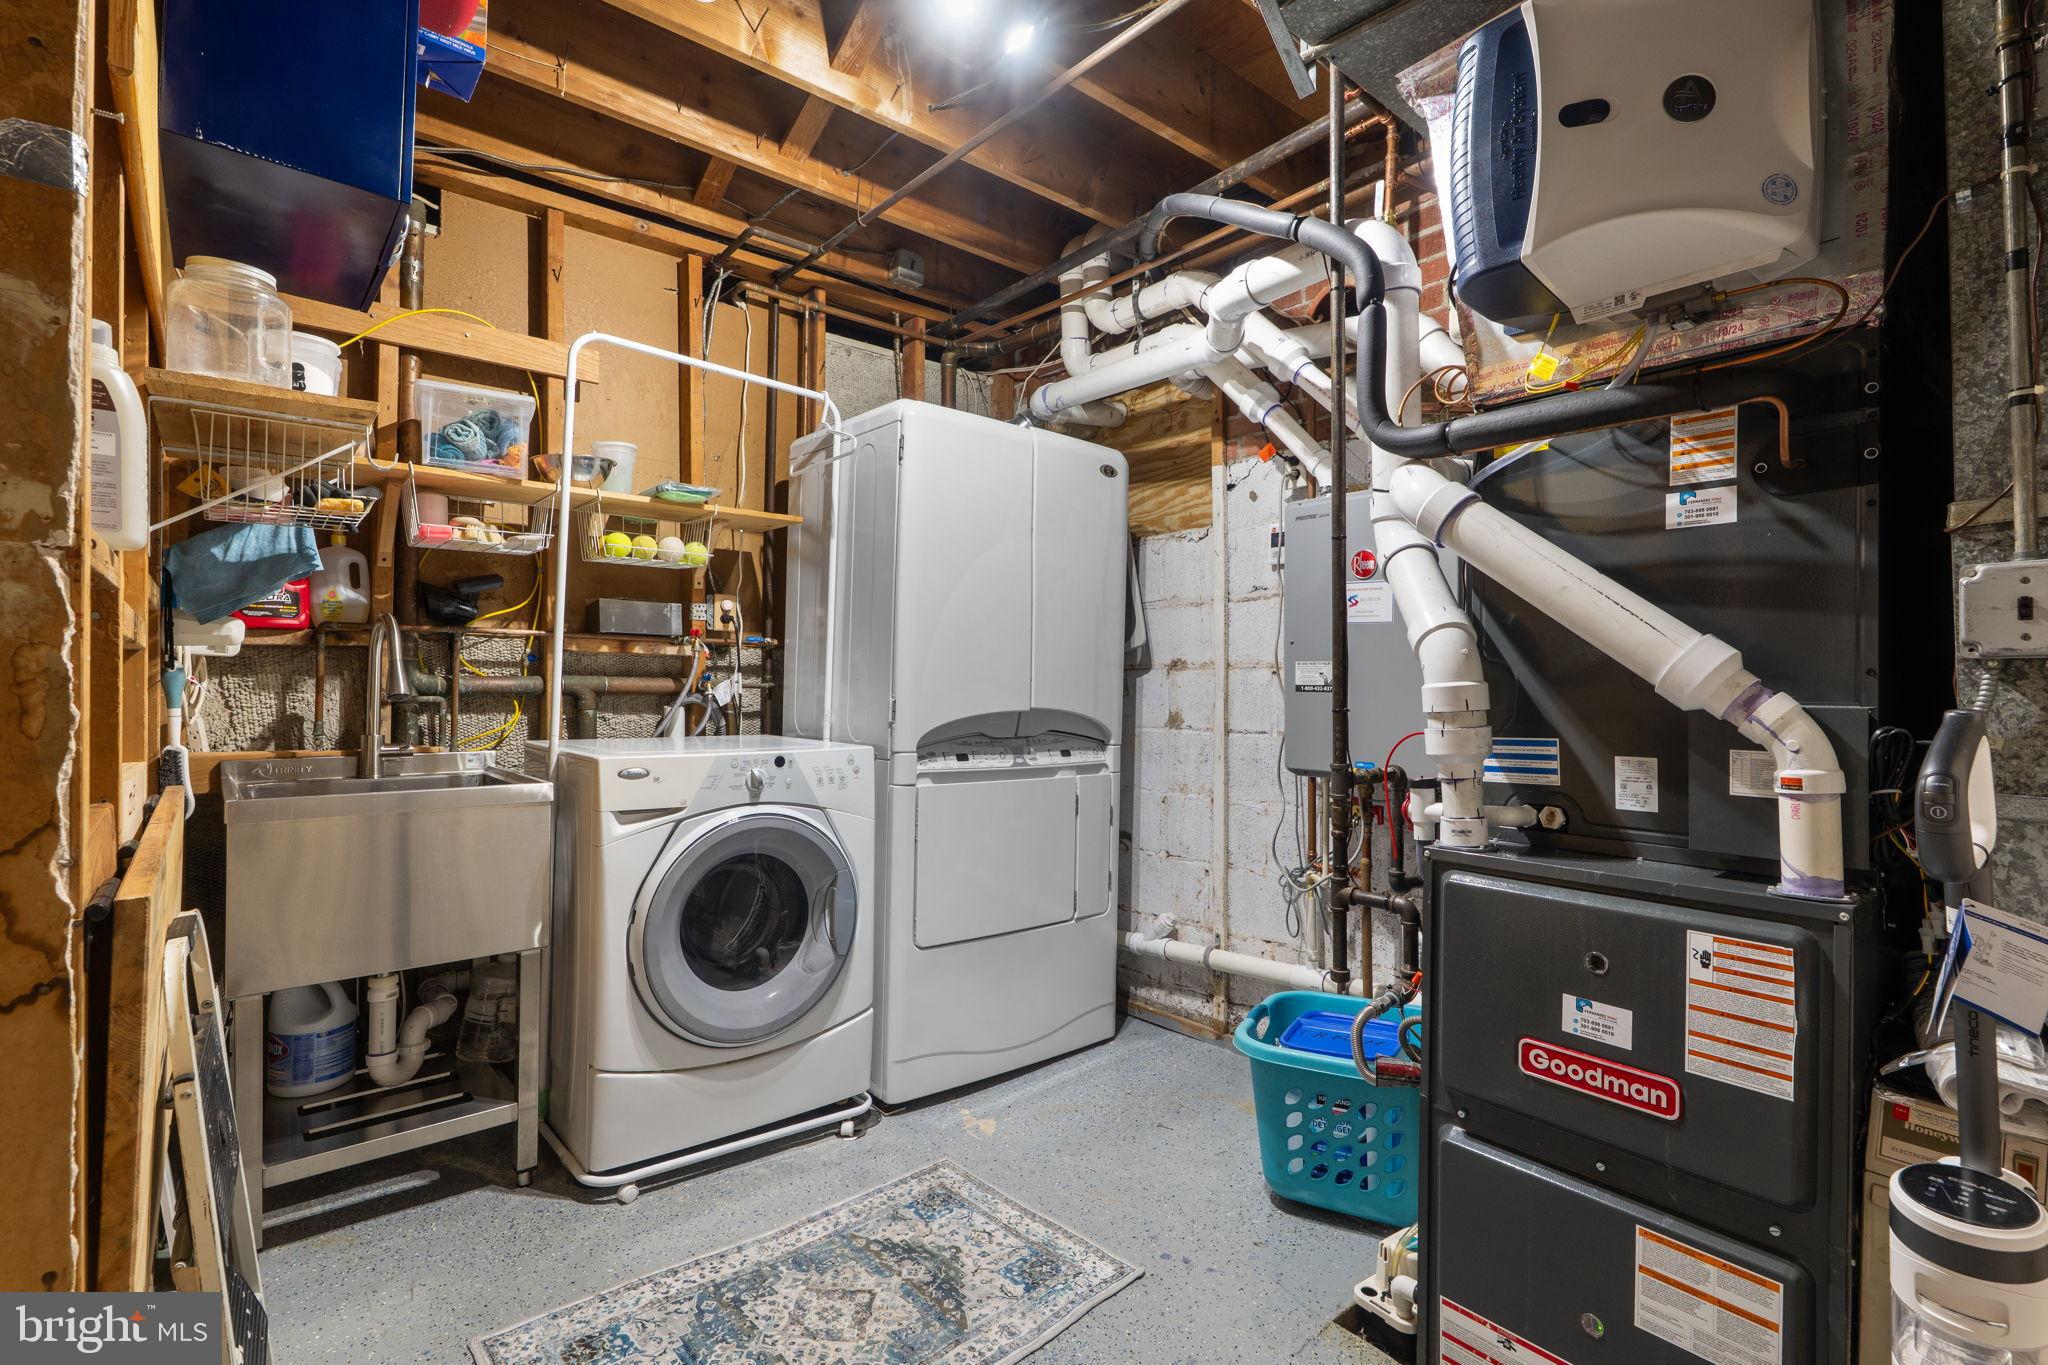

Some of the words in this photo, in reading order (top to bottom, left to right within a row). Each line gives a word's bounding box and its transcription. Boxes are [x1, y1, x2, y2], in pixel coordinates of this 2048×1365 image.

[1716, 323, 1744, 338] 10/24
[1354, 552, 1375, 575] Rheem
[275, 764, 313, 774] TRINITY
[1528, 1048, 1668, 1109] Goodman
[1904, 1121, 1960, 1144] Honeyw
